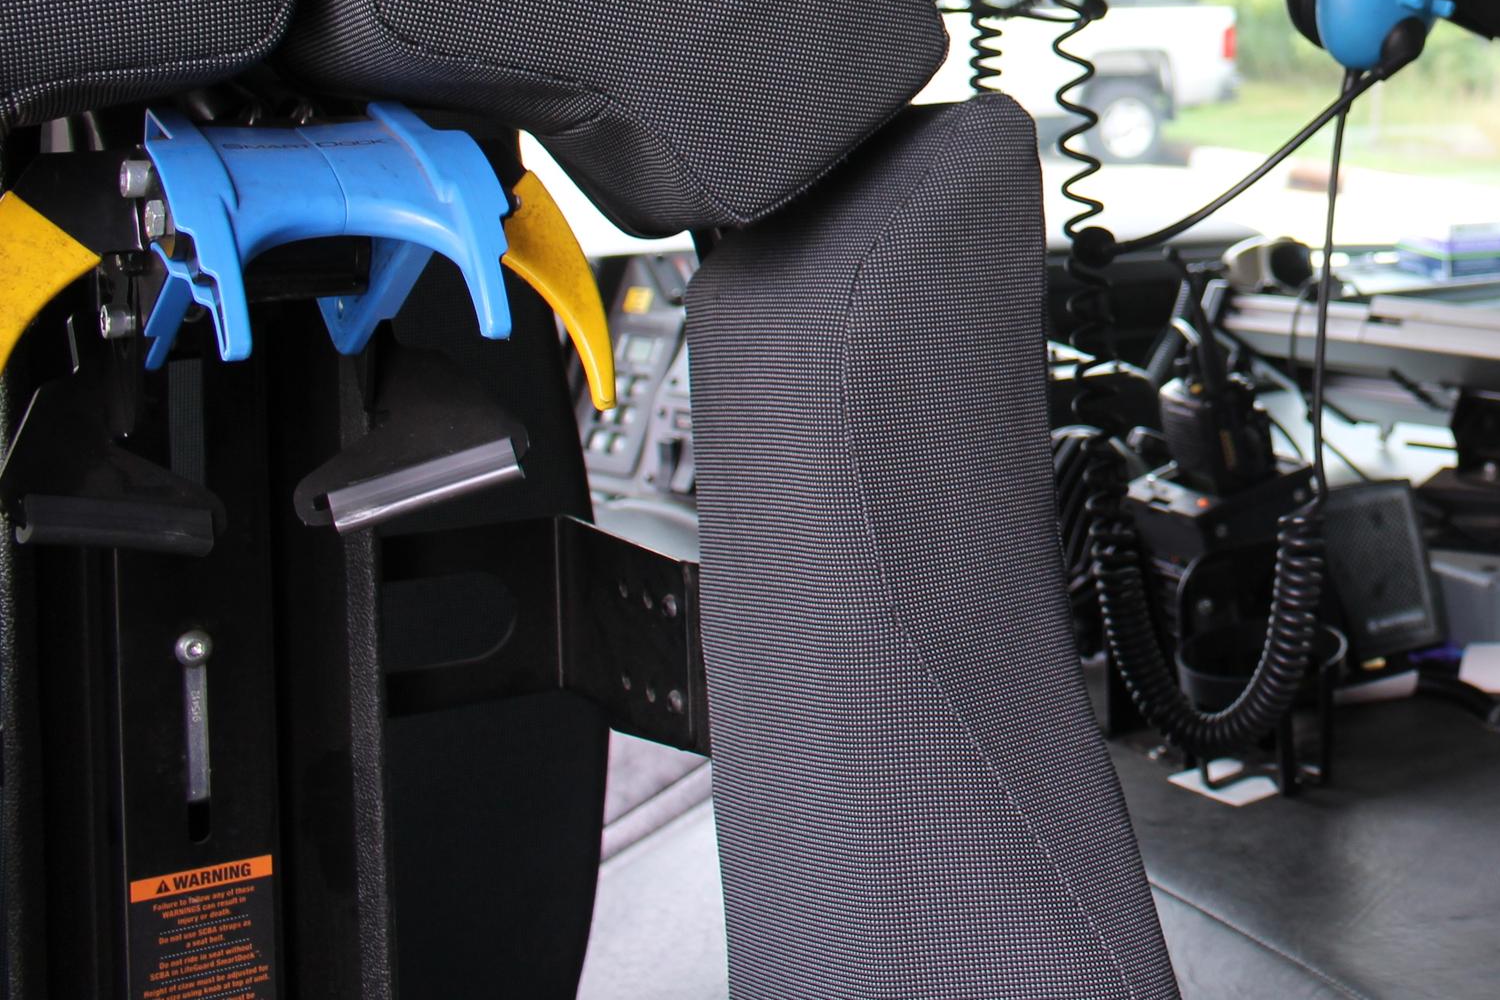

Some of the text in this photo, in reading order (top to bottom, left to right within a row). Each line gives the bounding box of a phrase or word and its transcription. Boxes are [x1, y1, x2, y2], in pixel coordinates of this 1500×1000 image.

[173, 863, 252, 890] WARNING
[152, 902, 178, 912] Failure
[211, 892, 226, 901] any
[226, 888, 234, 896] of
[235, 885, 256, 895] these
[162, 904, 201, 919] WARNINGS
[202, 902, 216, 911] can
[217, 897, 238, 908] result
[159, 919, 252, 945] Do not use SCBA straps as
[177, 915, 200, 926] injury
[192, 938, 208, 948] seat
[159, 961, 169, 970] Do
[170, 958, 183, 968] not
[184, 954, 198, 965] ride
[208, 949, 224, 959] seat
[225, 943, 253, 955] without
[143, 986, 168, 999] Height
[169, 984, 177, 992] of
[178, 981, 196, 991] claw
[196, 976, 215, 987] must
[216, 974, 226, 982] be
[226, 967, 257, 981] adjusted
[258, 964, 269, 973] for
[150, 969, 170, 981] SCBA
[171, 969, 179, 977] in
[182, 989, 202, 1000] using
[203, 984, 222, 994] knob
[232, 979, 244, 988] top
